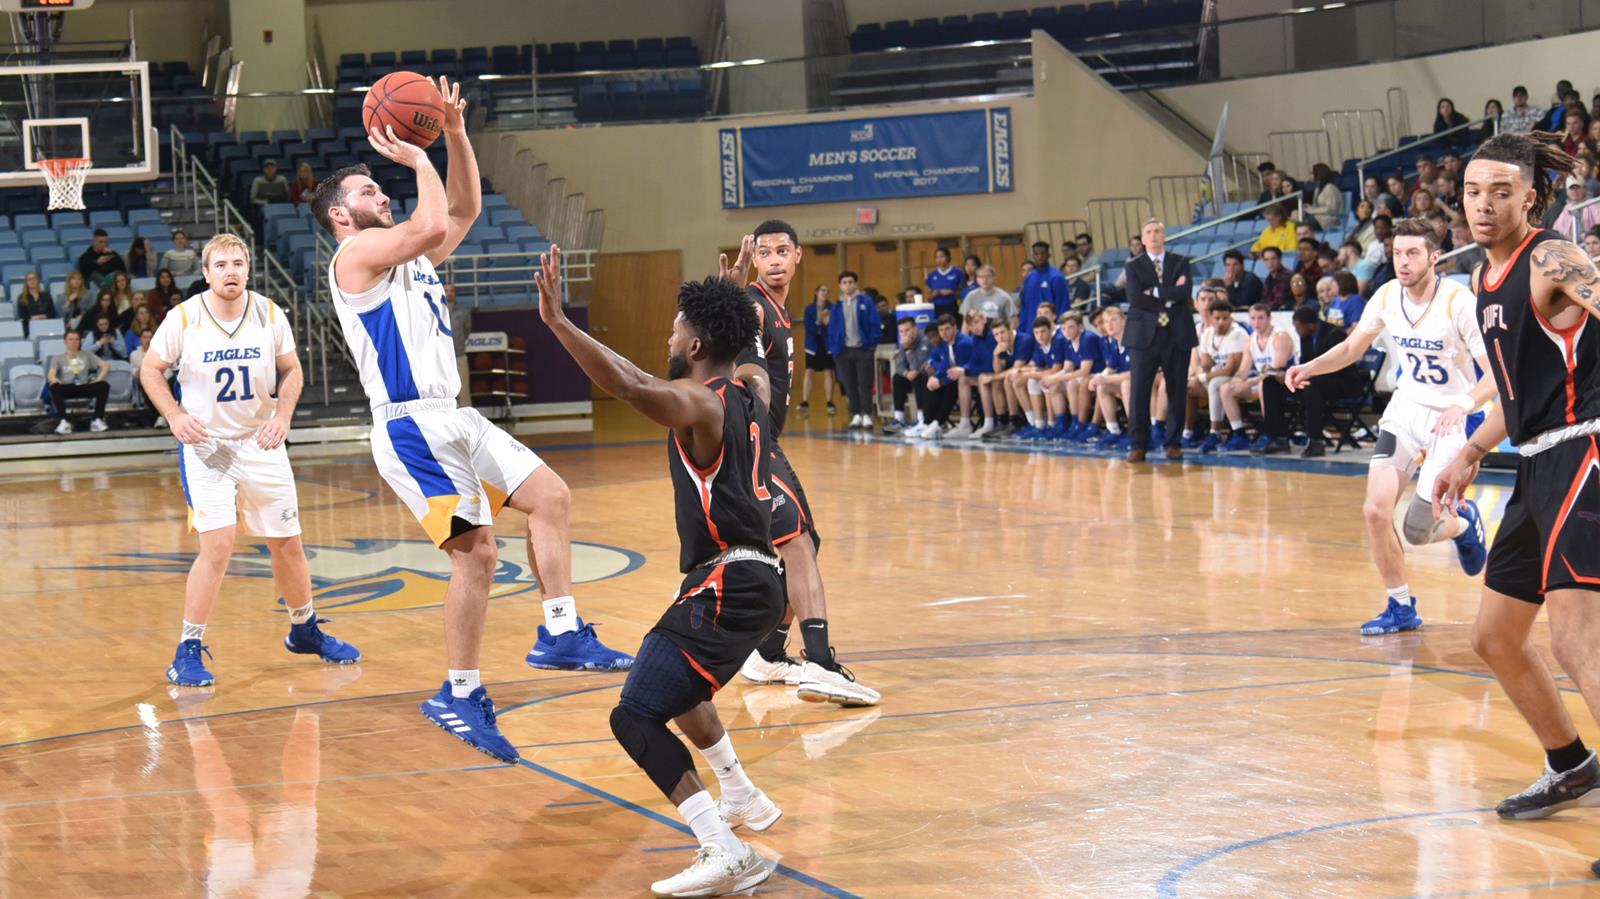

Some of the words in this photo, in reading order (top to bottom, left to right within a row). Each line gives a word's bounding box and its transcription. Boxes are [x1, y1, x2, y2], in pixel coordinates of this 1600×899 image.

[808, 150, 857, 167] MEN'S
[859, 146, 917, 163] SOCCER
[994, 112, 1010, 187] EAGLES
[722, 132, 737, 205] EAGLES
[874, 169, 919, 179] NATIONAL
[922, 165, 980, 177] CHAMPIONS
[751, 178, 796, 188] REGIONAL
[798, 173, 854, 184] CHAMPIONS
[790, 184, 815, 194] 2017
[912, 176, 939, 187] 2017
[202, 346, 262, 363] EAGLES
[1405, 352, 1450, 385] 25
[214, 364, 255, 403] 21
[749, 421, 772, 501] 2
